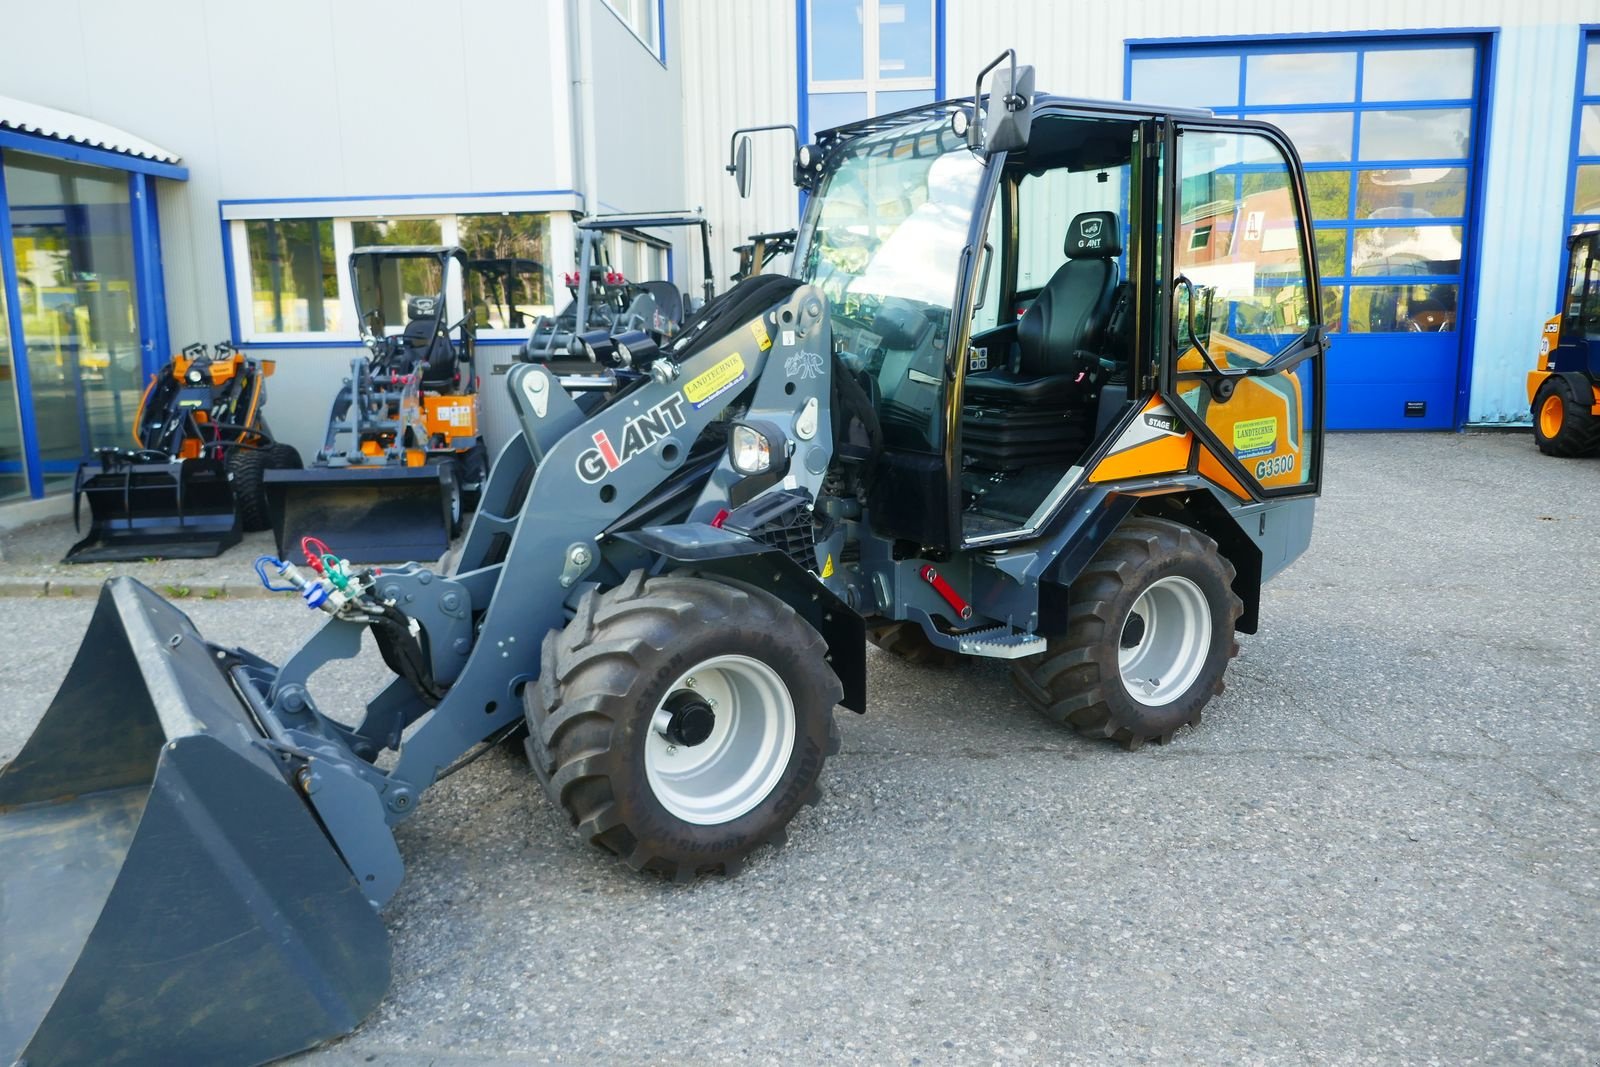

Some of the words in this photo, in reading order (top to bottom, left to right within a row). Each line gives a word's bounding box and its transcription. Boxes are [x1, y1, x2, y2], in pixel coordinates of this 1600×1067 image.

[1078, 238, 1101, 248] GANT
[1544, 323, 1558, 333] JCB
[686, 358, 738, 394] LANDTECHNIK
[1148, 417, 1170, 430] STAGE
[1171, 417, 1181, 431] V
[1236, 425, 1274, 439] LANDTECHNIK
[1255, 453, 1294, 480] G3500
